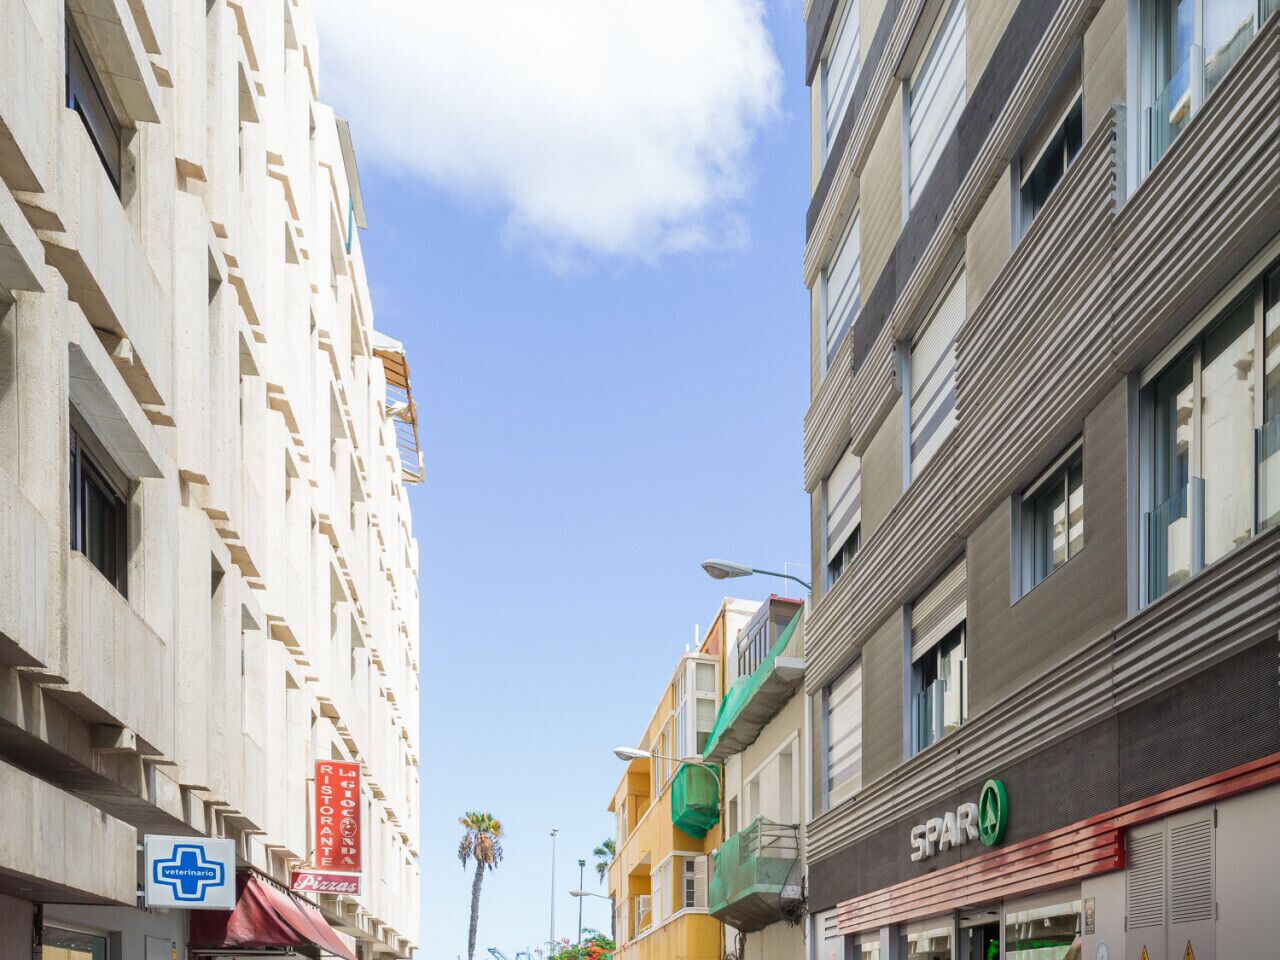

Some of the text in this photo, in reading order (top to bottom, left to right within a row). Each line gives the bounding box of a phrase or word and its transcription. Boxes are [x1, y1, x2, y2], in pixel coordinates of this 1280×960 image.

[338, 768, 357, 777] La
[319, 765, 334, 867] RISTORANTE
[910, 802, 979, 862] SPAR
[164, 869, 214, 877] veterinario
[294, 874, 357, 892] Pizzas
